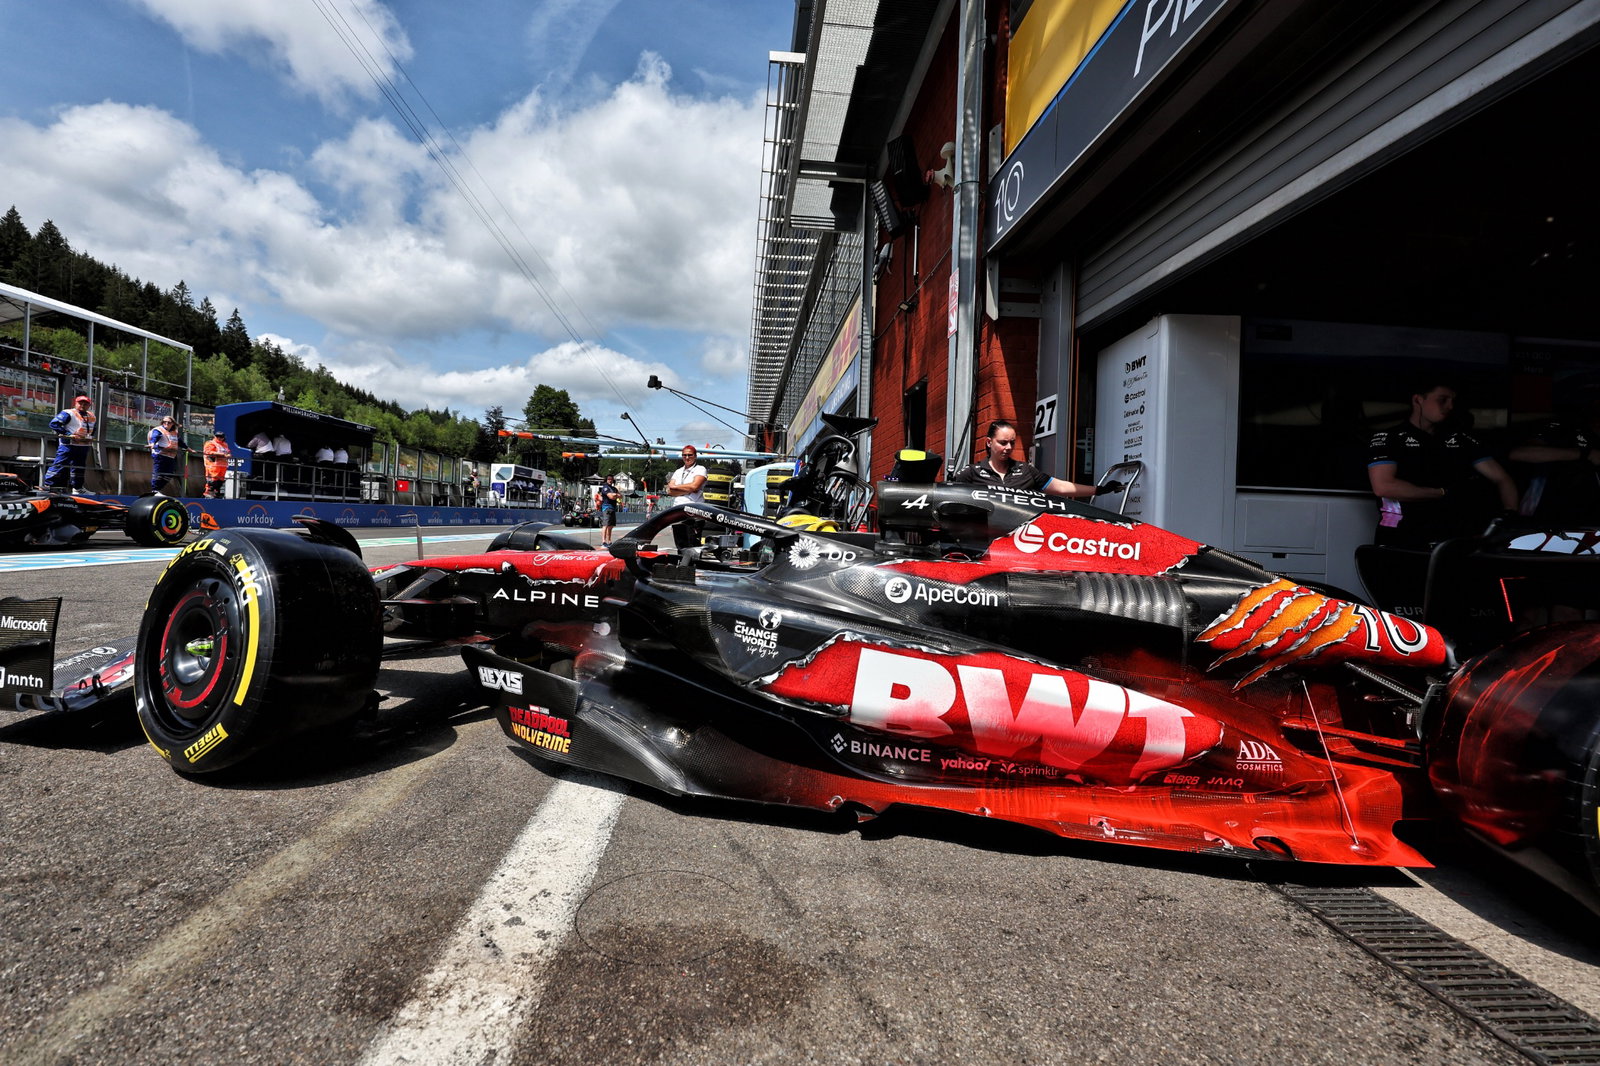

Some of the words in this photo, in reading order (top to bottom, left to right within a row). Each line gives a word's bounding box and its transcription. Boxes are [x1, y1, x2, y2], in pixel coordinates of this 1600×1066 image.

[1035, 399, 1057, 436] 27
[971, 490, 1066, 510] E-TECH
[988, 485, 1047, 497] RENAULT
[724, 515, 767, 534] businessolver
[828, 548, 856, 562] bp
[1047, 532, 1140, 560] Castrol
[493, 587, 599, 608] ALPINE
[914, 583, 999, 607] ApeCoin
[0, 615, 48, 632] Microsoft
[735, 625, 778, 641] CHANGE
[1352, 603, 1428, 656] 10
[742, 635, 777, 649] WORLD
[7, 674, 43, 688] mntn
[478, 665, 523, 695] HEXIS
[508, 706, 571, 738] DEADPOOL
[850, 647, 1196, 779] BWT
[511, 722, 572, 754] WOLVERINE
[851, 740, 931, 762] BINANCE
[1237, 740, 1281, 760] ADA
[940, 757, 991, 771] yahoo!
[1018, 765, 1060, 777] sprinklr
[1236, 763, 1284, 772] COSMETICS
